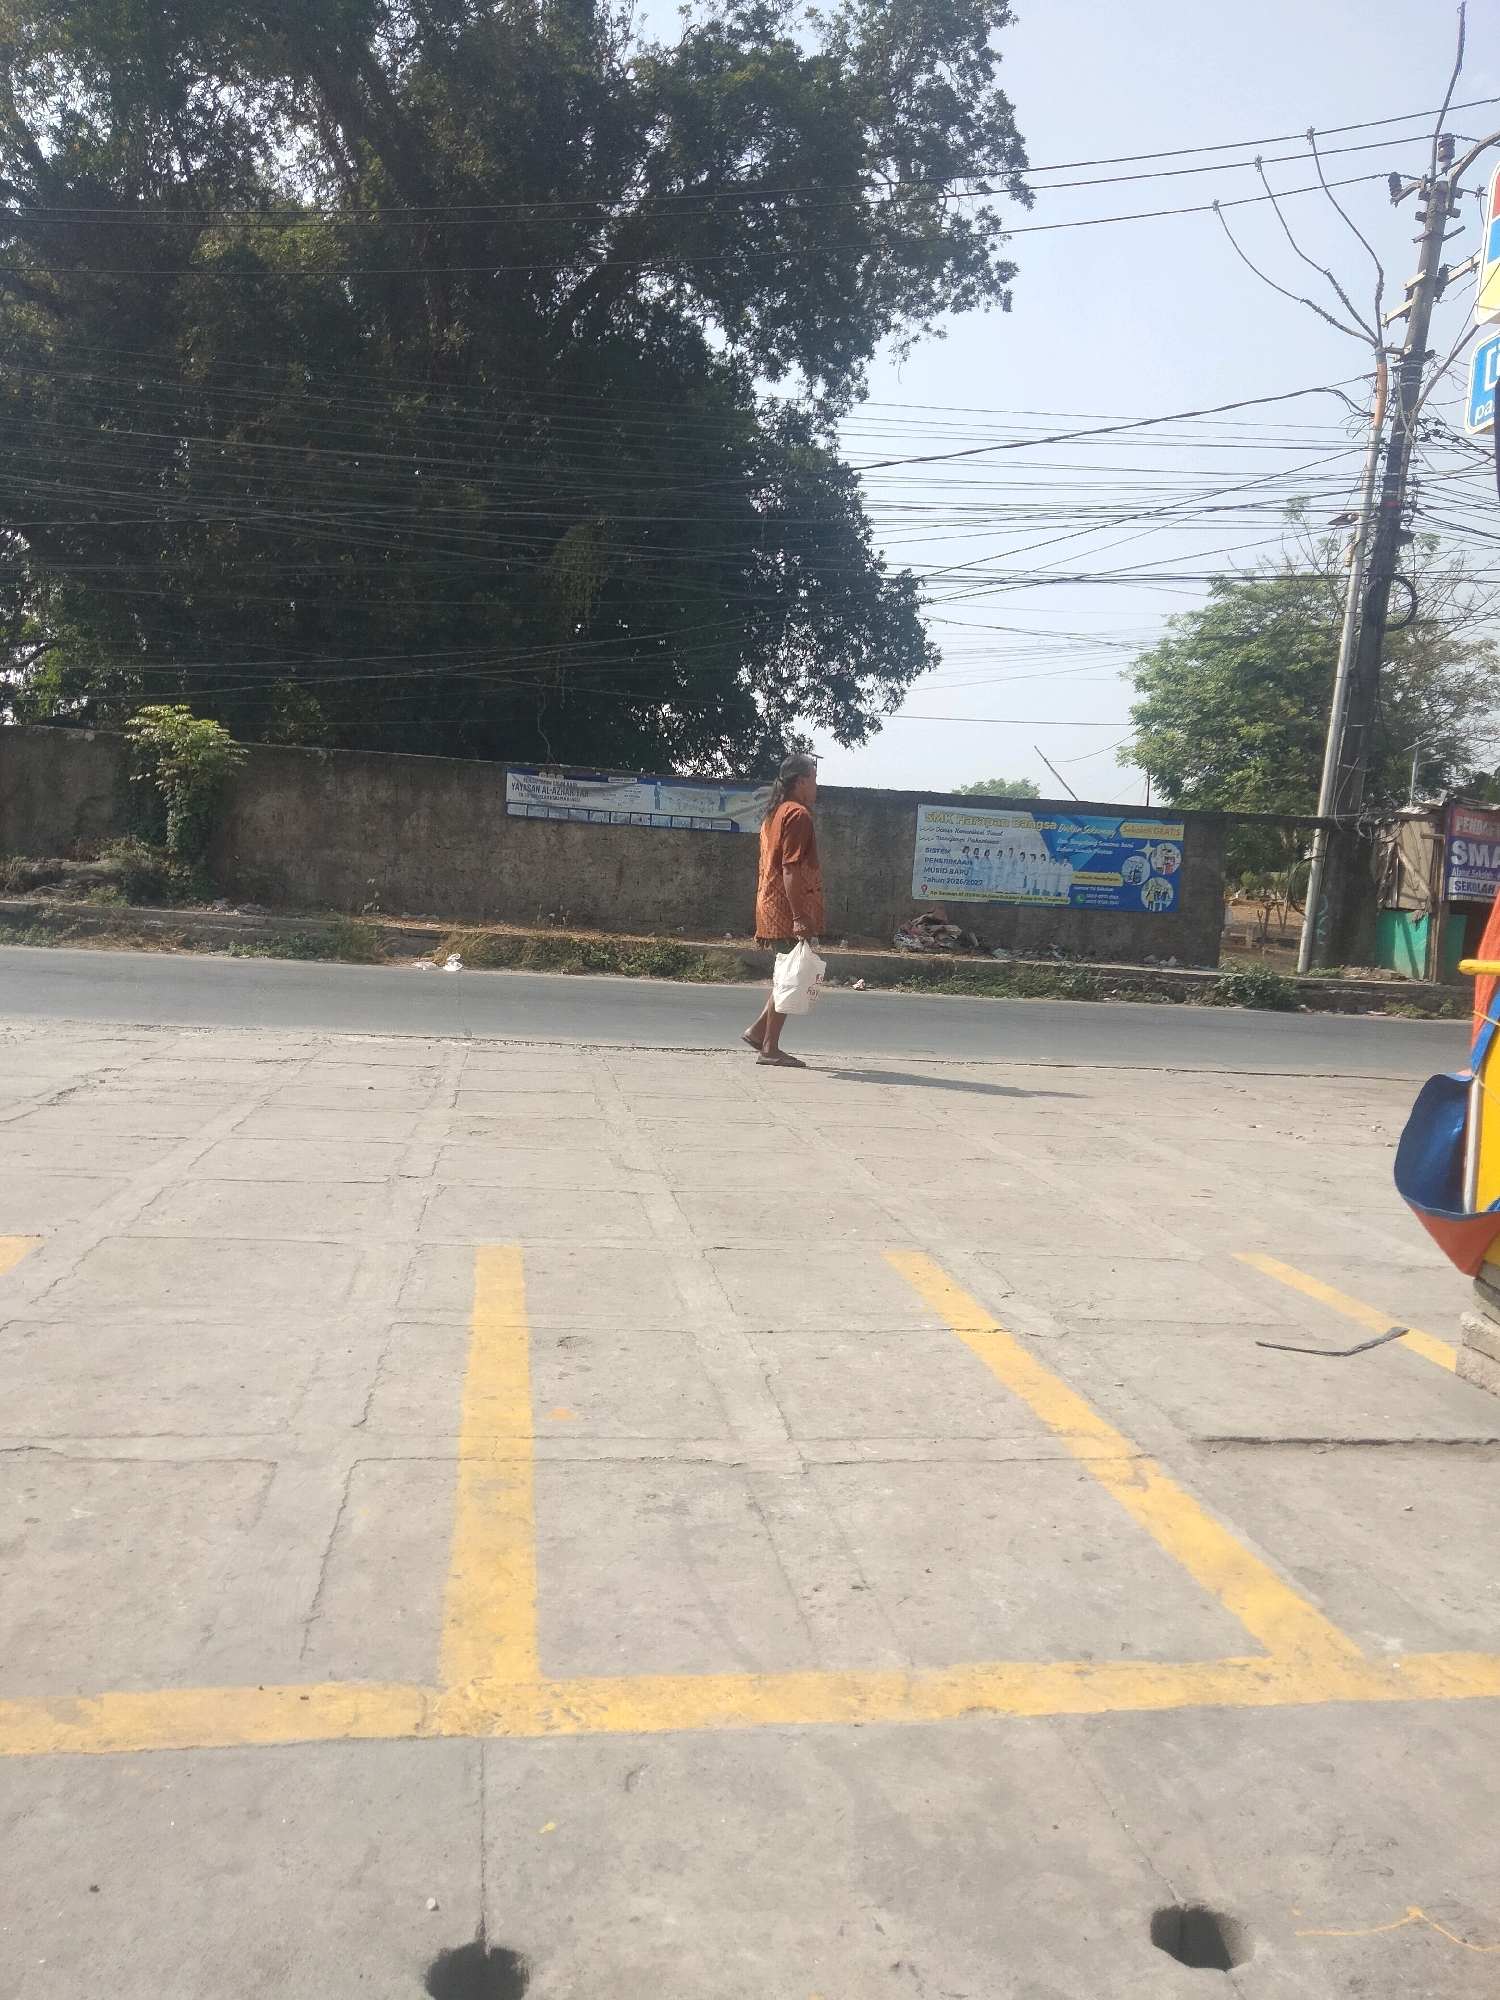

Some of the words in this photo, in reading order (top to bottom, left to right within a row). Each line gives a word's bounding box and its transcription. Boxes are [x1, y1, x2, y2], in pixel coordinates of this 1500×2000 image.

[511, 782, 540, 794] YAYASAN
[924, 811, 953, 824] SMK
[956, 813, 1009, 828] Harapan
[1011, 817, 1057, 832] Bangsa
[1082, 825, 1117, 839] Sekarang
[1123, 825, 1152, 835] Sekolah
[1153, 828, 1181, 837] GRATIS
[924, 857, 973, 866] PENERIMAAN
[949, 868, 969, 876] BARU
[923, 876, 945, 884] Tahun
[946, 878, 983, 886] 2026/2027
[1454, 880, 1496, 894] SEKOLAH
